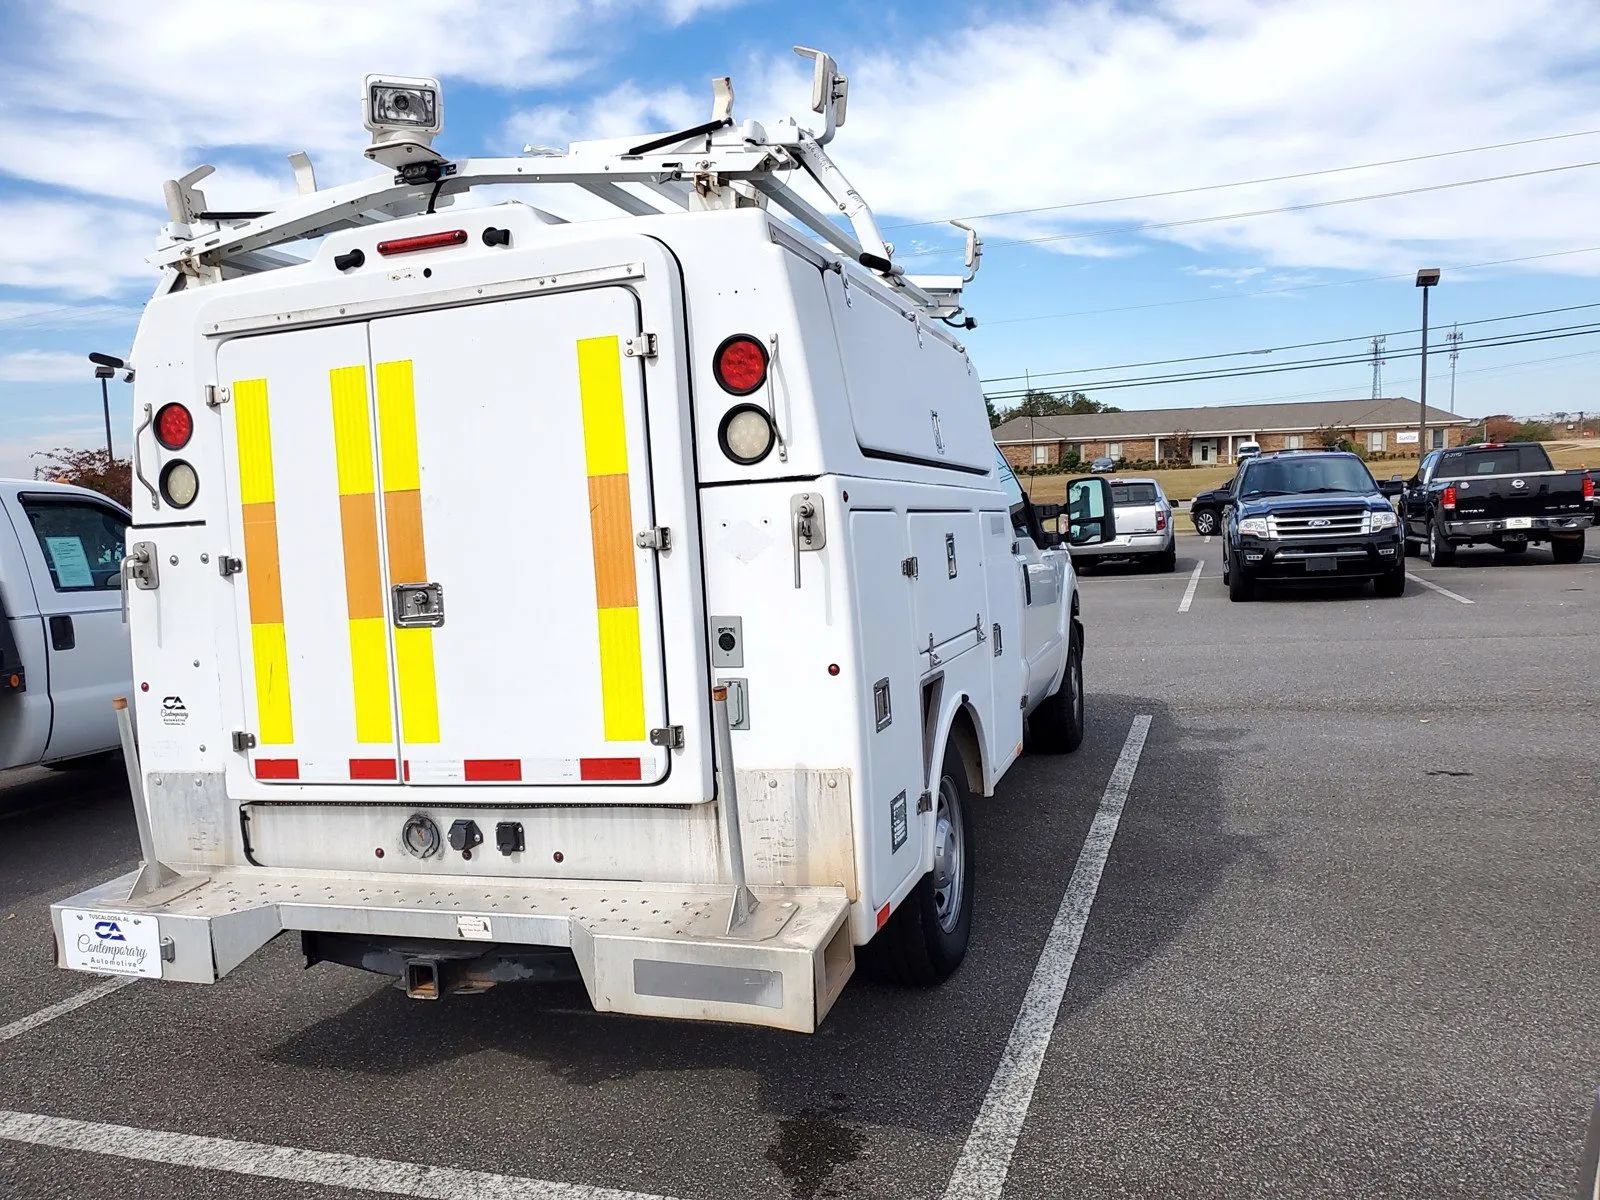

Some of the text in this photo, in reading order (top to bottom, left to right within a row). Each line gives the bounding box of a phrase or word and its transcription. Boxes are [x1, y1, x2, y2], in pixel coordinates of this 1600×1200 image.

[160, 709, 188, 720] Contemporary
[89, 914, 123, 922] TUSCALOOSA,
[77, 933, 147, 965] Contemporary
[90, 957, 137, 968] Automotive
